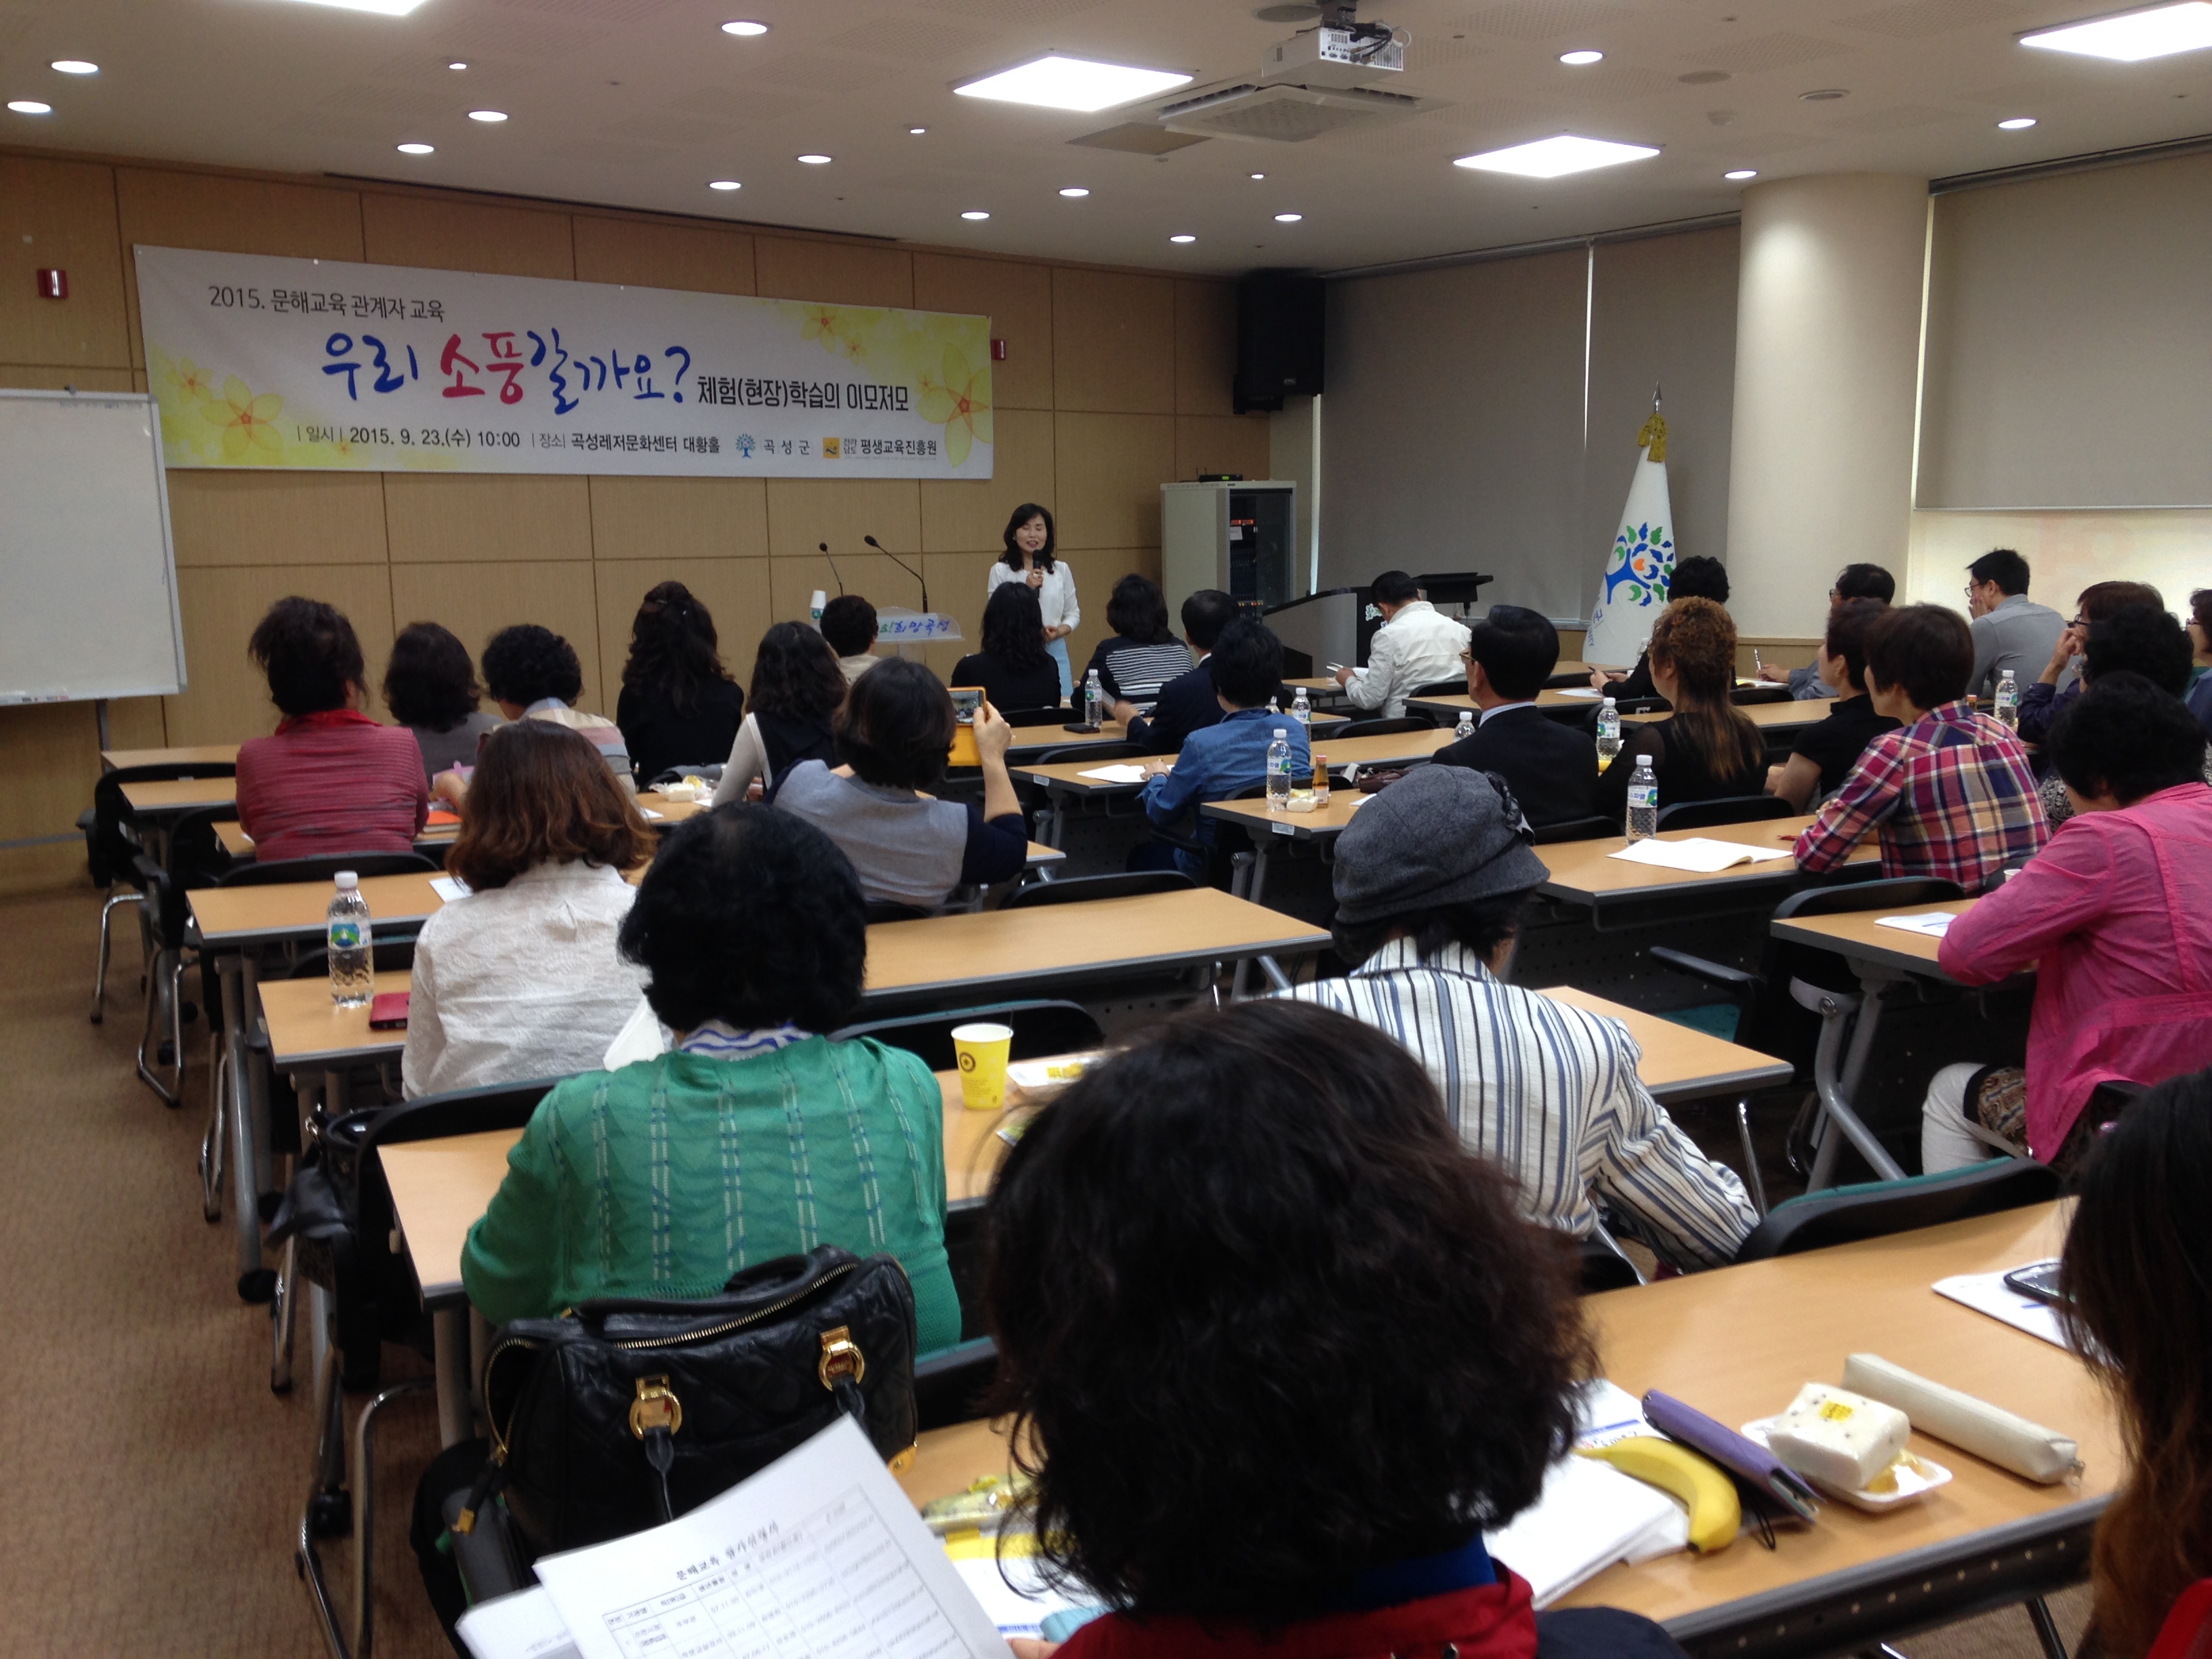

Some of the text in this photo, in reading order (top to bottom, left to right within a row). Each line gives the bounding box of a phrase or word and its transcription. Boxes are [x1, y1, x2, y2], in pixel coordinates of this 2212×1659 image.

[209, 286, 445, 323] 2015. 문해교육 관계자 교육
[322, 332, 418, 401] 우리
[697, 376, 840, 409] 체험(현장)학습의
[846, 384, 909, 411] 이모저모
[350, 427, 394, 445] 2015.
[400, 428, 415, 445] 9.
[421, 428, 471, 448] 23.(수)
[478, 431, 520, 447] 10:00
[571, 433, 677, 453] 곡성레저문화센터
[683, 436, 720, 453] 대황홀
[861, 439, 937, 455] 평생교육진흥원
